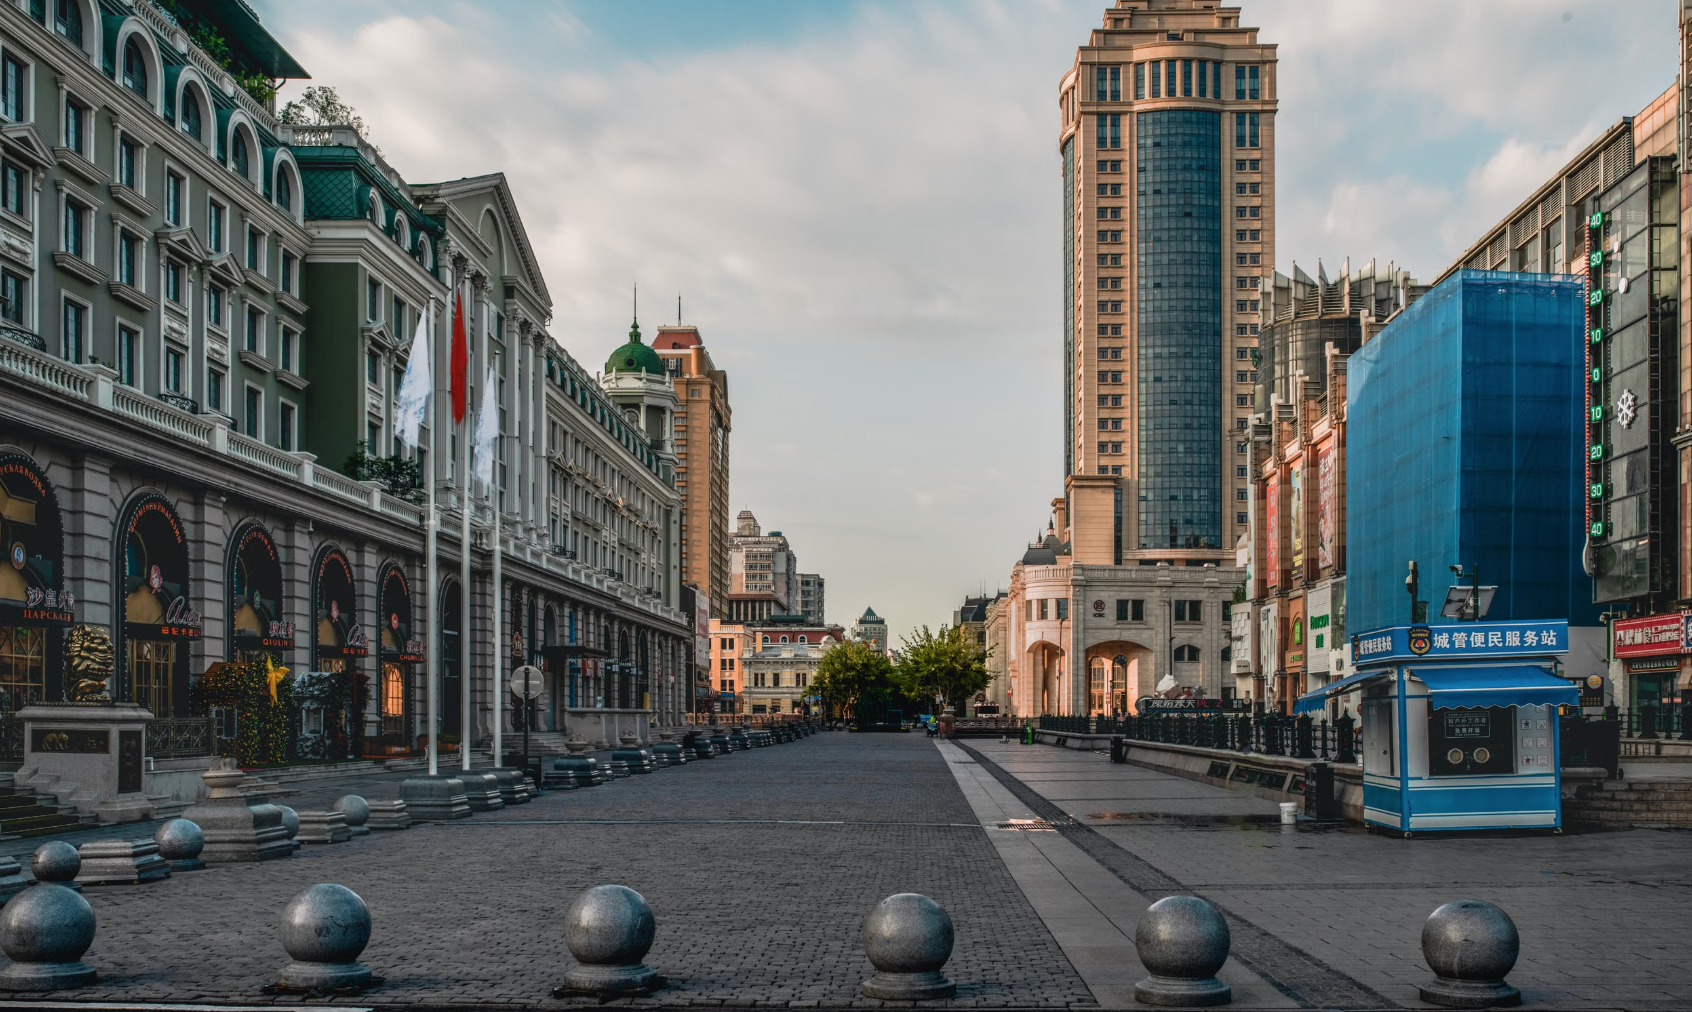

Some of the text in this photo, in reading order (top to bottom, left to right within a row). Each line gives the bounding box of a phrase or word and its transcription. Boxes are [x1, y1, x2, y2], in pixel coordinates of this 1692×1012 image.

[1591, 214, 1602, 226] 40
[1590, 252, 1602, 265] 30
[1590, 291, 1602, 303] 20
[1590, 329, 1602, 341] 10
[1593, 369, 1600, 381] 0
[1590, 406, 1602, 420] 10
[1590, 445, 1602, 459] 20
[1590, 484, 1602, 497] 30
[1590, 522, 1602, 535] 40
[1359, 635, 1392, 655] 城管便民服务站
[1433, 629, 1557, 649] 城管便民服务站
